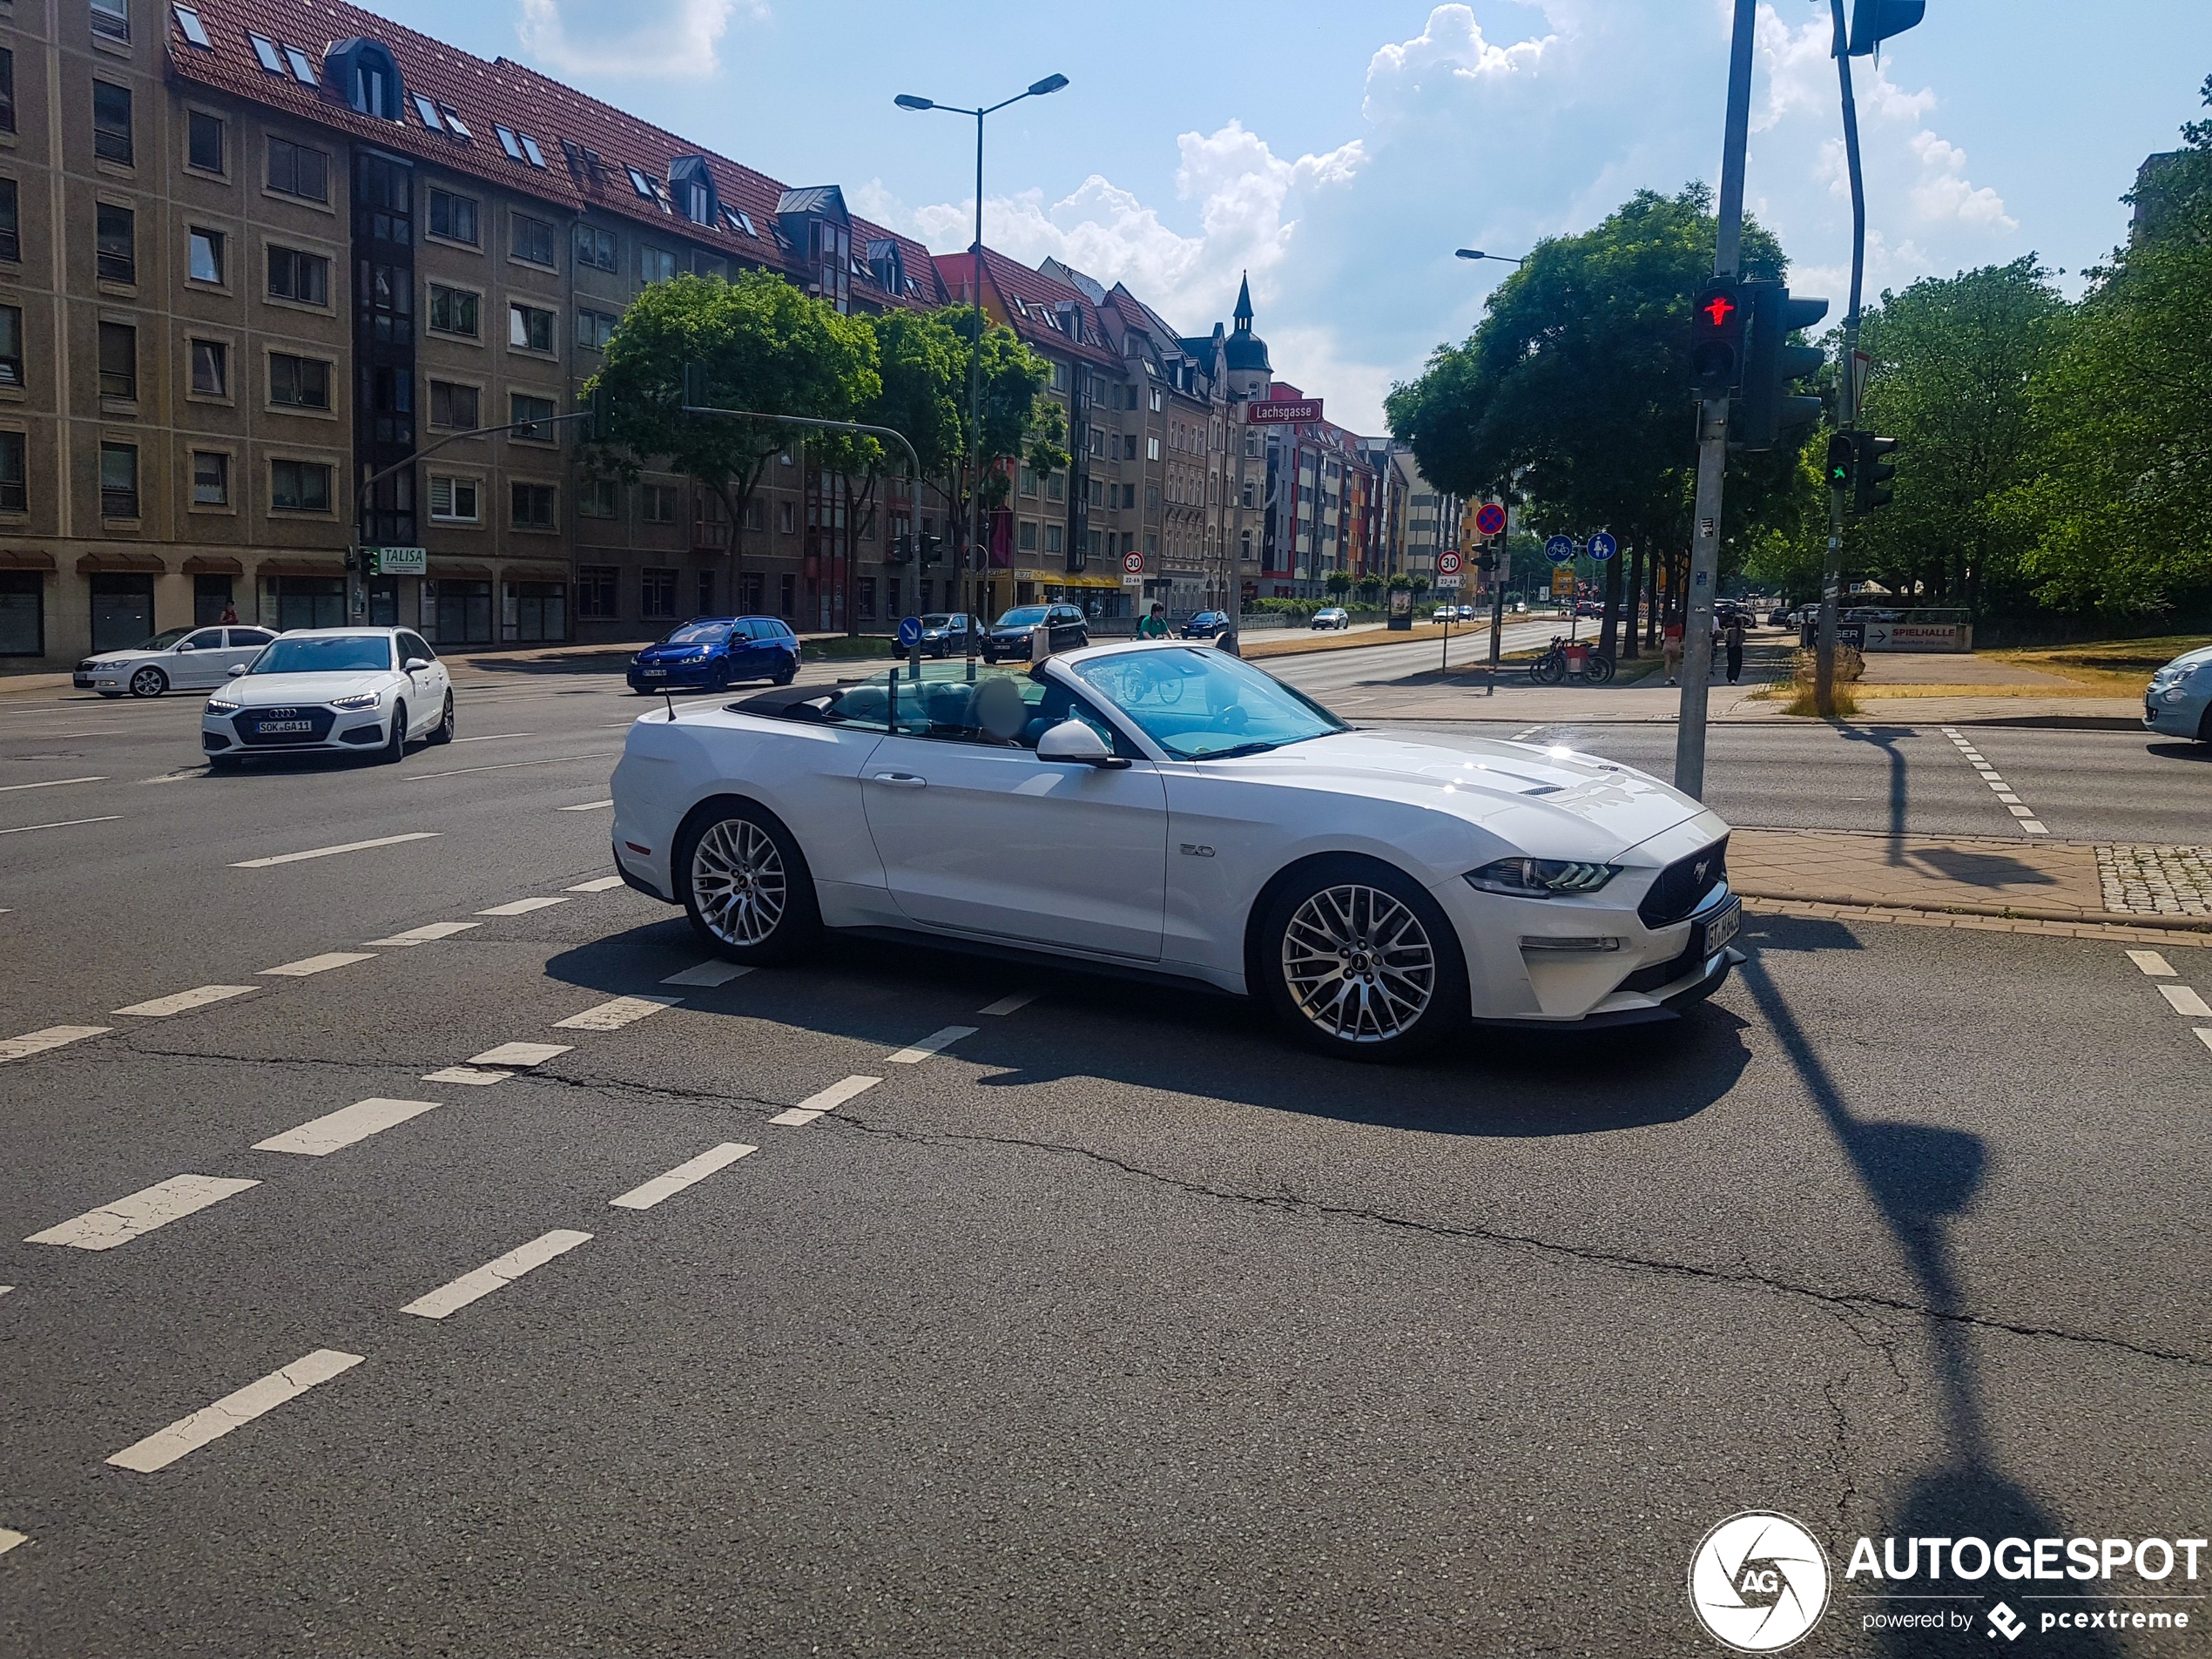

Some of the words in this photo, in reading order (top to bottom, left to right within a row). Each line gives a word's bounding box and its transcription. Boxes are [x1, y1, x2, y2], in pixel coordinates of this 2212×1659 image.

[1257, 406, 1312, 421] Lachsgasse
[385, 550, 422, 563] TALISA
[1128, 557, 1140, 568] 30
[1443, 557, 1457, 568] 30
[1892, 628, 1955, 637] SPIELHALLE
[260, 723, 278, 732] SOK
[1180, 843, 1216, 858] 5.0
